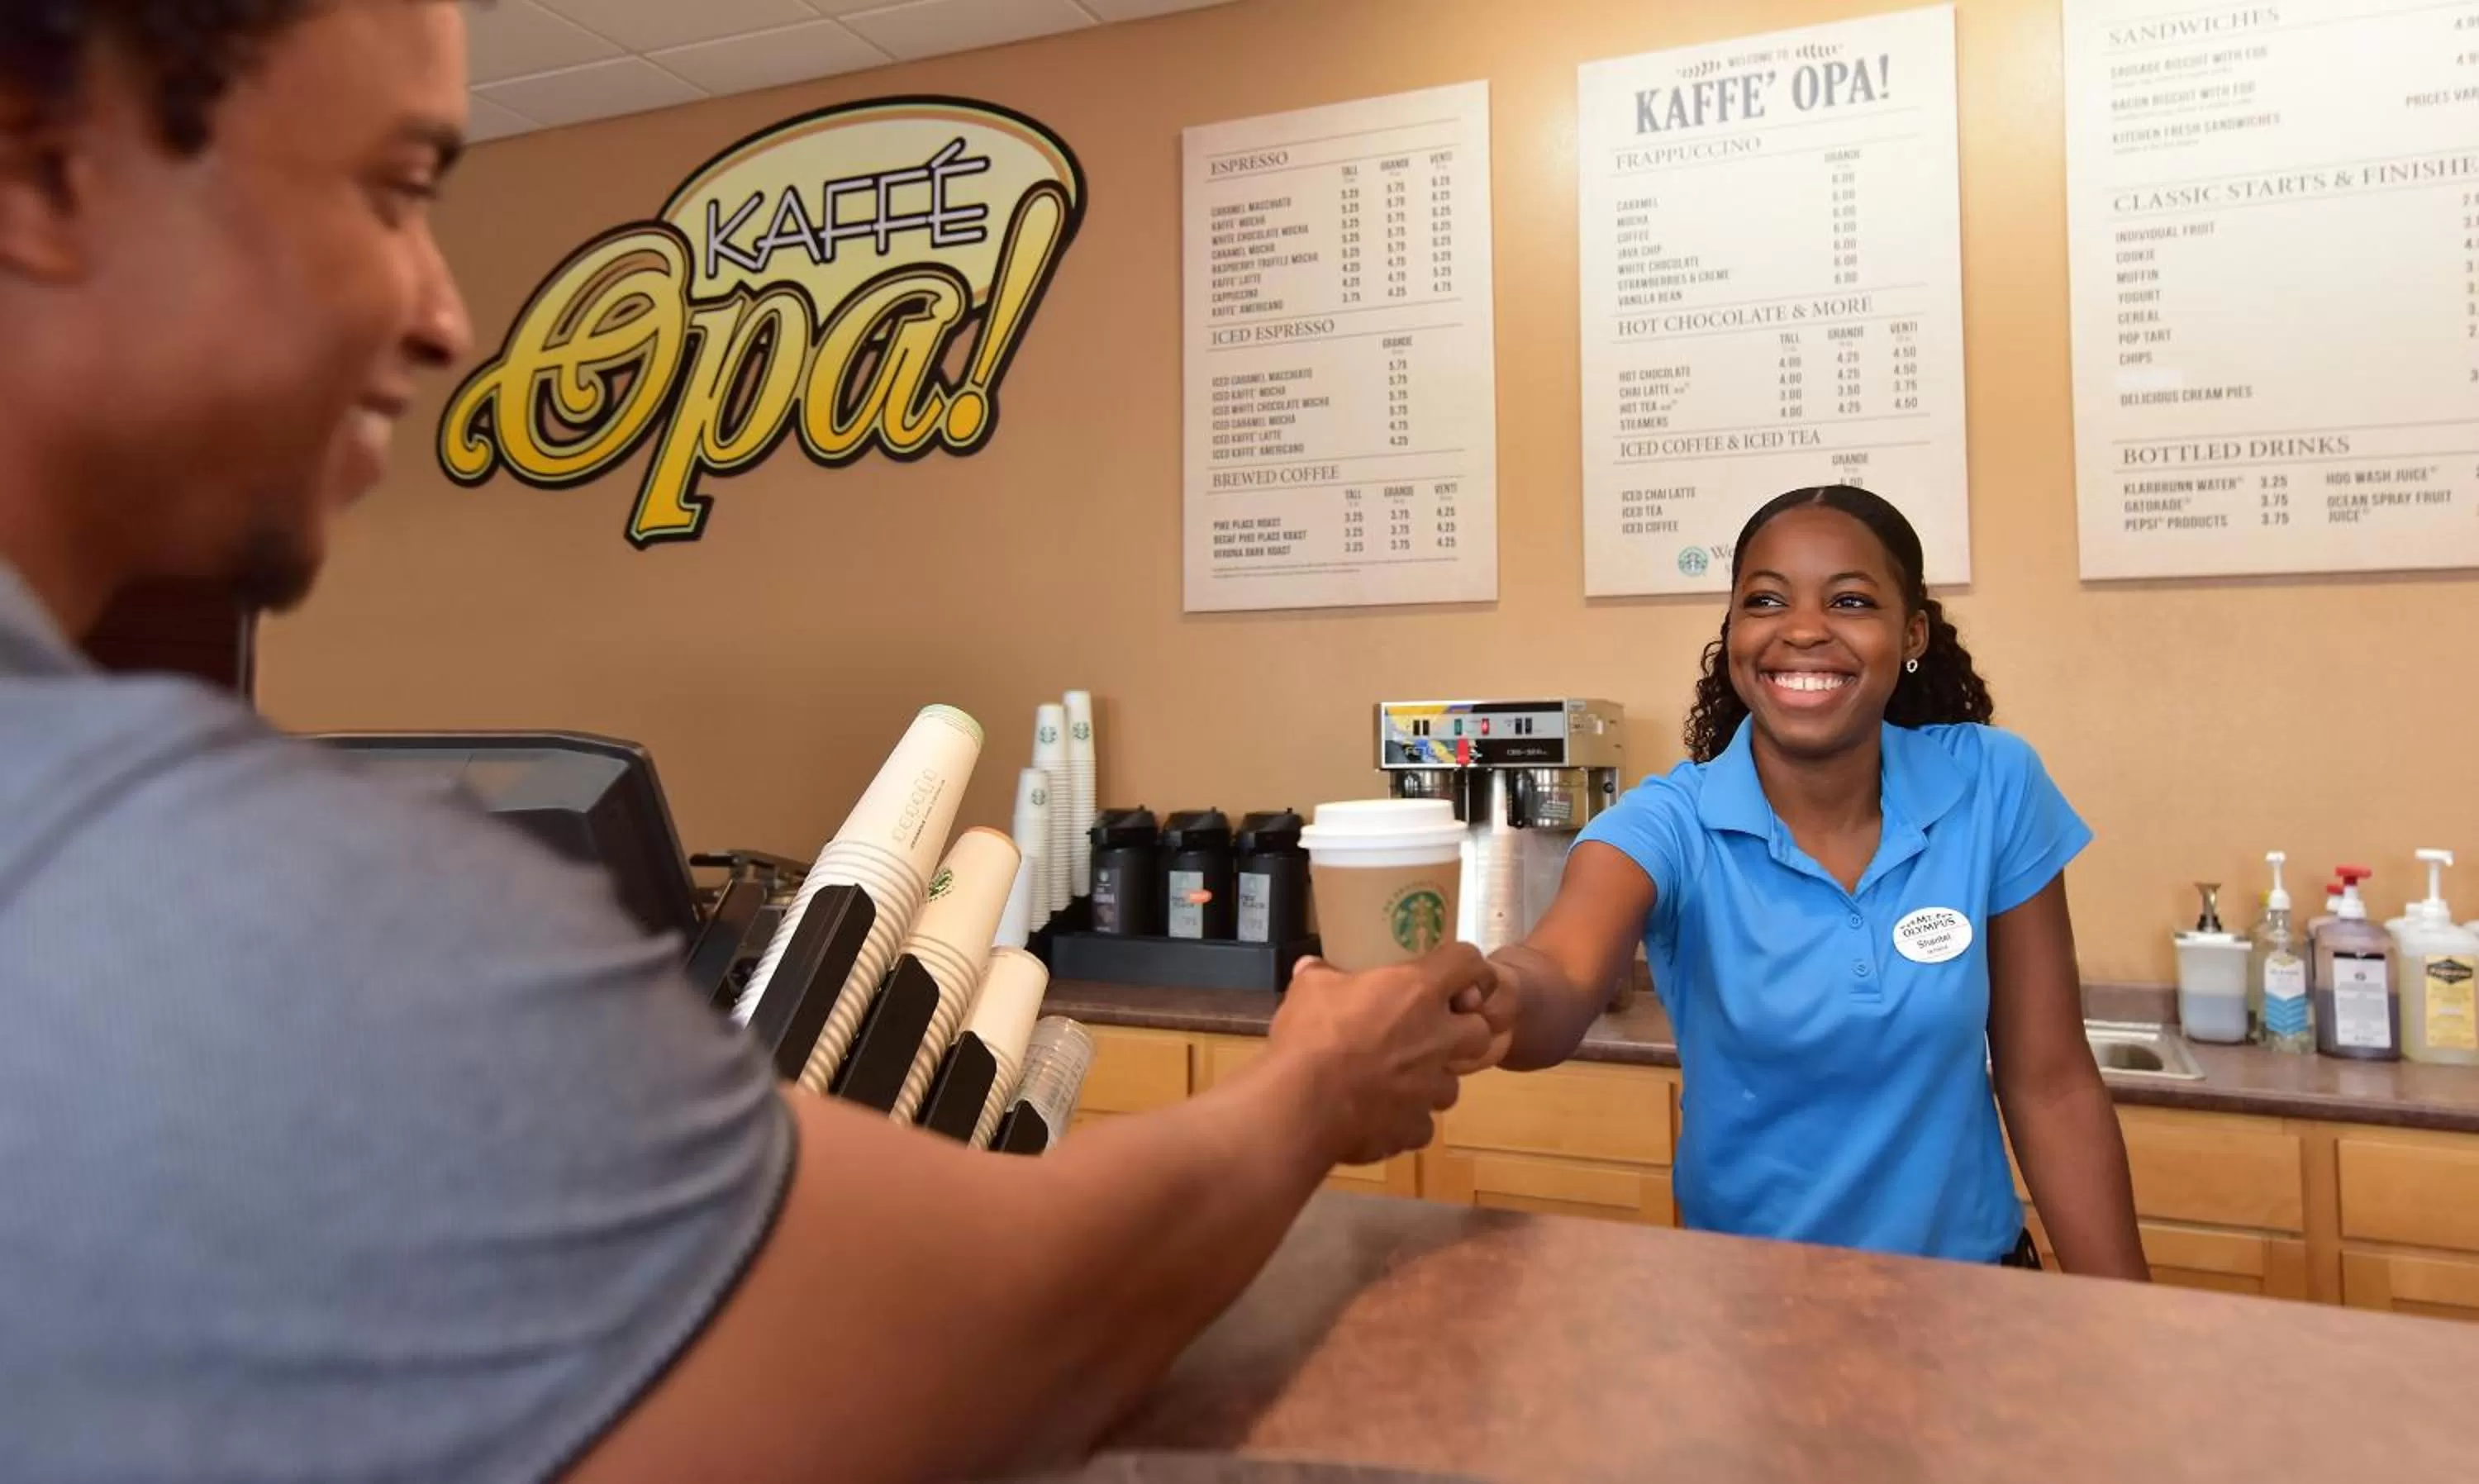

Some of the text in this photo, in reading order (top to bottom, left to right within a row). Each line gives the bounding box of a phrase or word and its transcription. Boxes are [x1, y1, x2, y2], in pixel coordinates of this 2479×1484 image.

[2108, 7, 2280, 47] SANDWICHES
[1792, 54, 1891, 112] OPA!
[2406, 90, 2449, 107] PRICES
[2205, 113, 2280, 135] SANDWICHES
[1616, 136, 1762, 171] FRAPPUCCINO
[1825, 150, 1860, 162] GRANDE
[1211, 151, 1288, 175] ESPRESSO
[2113, 188, 2222, 213] CLASSIC
[2227, 173, 2326, 199] STARTS
[2334, 170, 2352, 188] &
[705, 137, 989, 278] KAFFÉ
[1617, 198, 1657, 212] CARAMEL
[1617, 215, 1649, 227] MOCHA
[1211, 234, 1234, 245] WHITE
[1282, 225, 1308, 236] MOCHA
[1617, 229, 1649, 245] COFFEE
[2115, 221, 2215, 244] INDIVIDUAL FRUIT
[1211, 243, 1274, 259] CARAMEL MOCHA
[1618, 245, 1662, 259] JAVA CHIP
[2115, 248, 2154, 264] COOKIE
[1618, 256, 1699, 275] WHITE CHOCOLATE
[1618, 274, 1687, 292] STRAWBERRIES
[2117, 269, 2158, 283] MUFFIN
[1618, 291, 1682, 307] VANILLA BEAN
[2119, 289, 2160, 304] YOGURT
[1619, 296, 1872, 336] HOT CHOCOLATE & MORE
[2118, 311, 2159, 325] CEREAL
[1212, 320, 1335, 345] ICED ESPRESSO
[1780, 321, 1917, 344] TALL GRANDE VENTI
[2119, 330, 2170, 345] POP TART
[1382, 336, 1412, 349] GRANDE
[436, 178, 1074, 549] Opa!
[1779, 345, 1916, 368] 4.00 4.25 4.50
[2120, 351, 2153, 365] CHIPS
[1212, 377, 1230, 387] ICED
[1230, 373, 1266, 386] CARAMEL
[1620, 366, 1690, 383] HOT CHOCOLATE
[1780, 363, 1917, 385] 4.00 4.25 4.50
[1620, 387, 1641, 398] CHAI
[1644, 383, 1668, 397] LATTE
[1838, 383, 1860, 397] 3.50
[1894, 378, 1917, 392] 3.75
[2120, 385, 2252, 407] DELICIOUS CREAM PIES
[1212, 397, 1329, 416] ICED WHITE CHOCOLATE MOCHA
[1620, 402, 1636, 415] HOT
[1640, 402, 1657, 412] TEA
[1781, 397, 1917, 417] 4.00 4.25 4.50
[1620, 416, 1668, 430] STEAMERS
[1212, 434, 1230, 445] ICED
[1259, 430, 1281, 441] LATTE
[1620, 429, 1820, 458] ICED COFFEE & ICED TEA
[2123, 436, 2350, 465] BOTTLED DRINKS
[1832, 453, 1868, 466] GRANDE
[1213, 465, 1339, 487] BREWED COFFEE
[2261, 476, 2287, 489] 3.25
[2326, 472, 2351, 485] HOG
[2355, 470, 2391, 483] WASH
[1345, 483, 1457, 500] TALL GRANDE VENTI
[1622, 487, 1696, 502] ICED CHAI LATTE
[2261, 493, 2288, 507] 3.75
[2327, 489, 2452, 508] OCEAN SPRAY FRUIT
[1622, 505, 1663, 519] ICED TEA
[2167, 515, 2228, 529] PRODUCTS
[2262, 512, 2289, 526] 3.75
[1213, 517, 1281, 530] PIKE PLACE ROAST
[1622, 521, 1678, 534] ICED COFFEE
[1903, 917, 1955, 937] OLYMPUS
